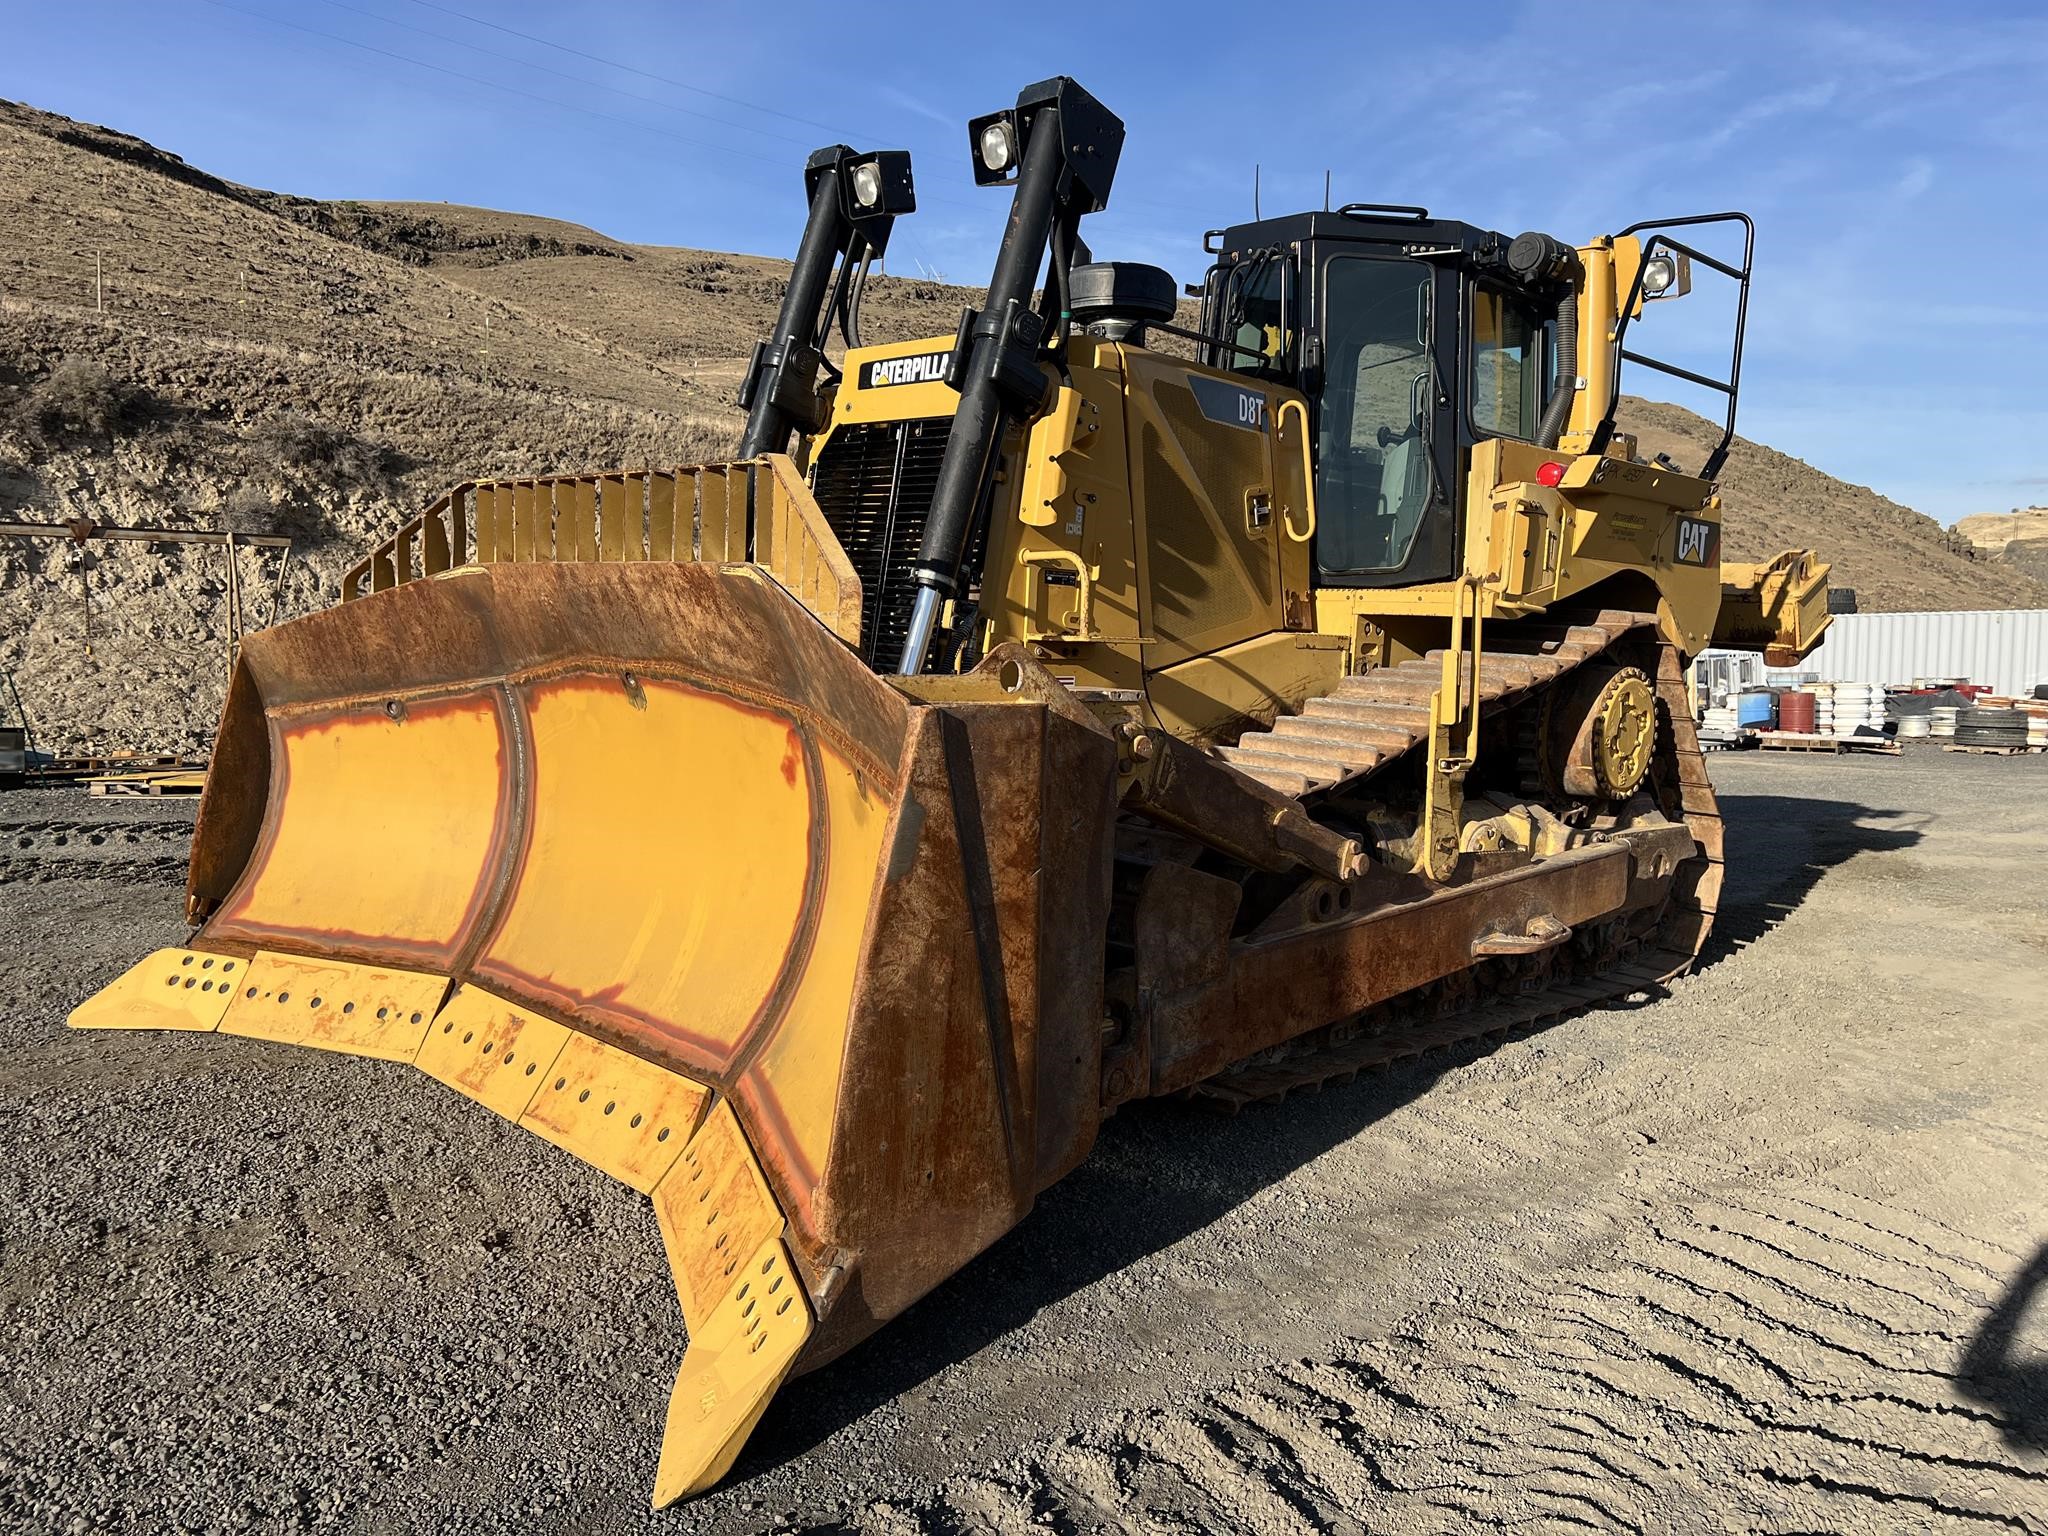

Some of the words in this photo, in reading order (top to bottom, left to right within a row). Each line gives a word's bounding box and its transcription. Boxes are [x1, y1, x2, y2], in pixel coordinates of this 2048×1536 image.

[871, 353, 949, 386] CATERPILLA
[1239, 394, 1264, 425] D8T
[1679, 521, 1709, 563] CAT
